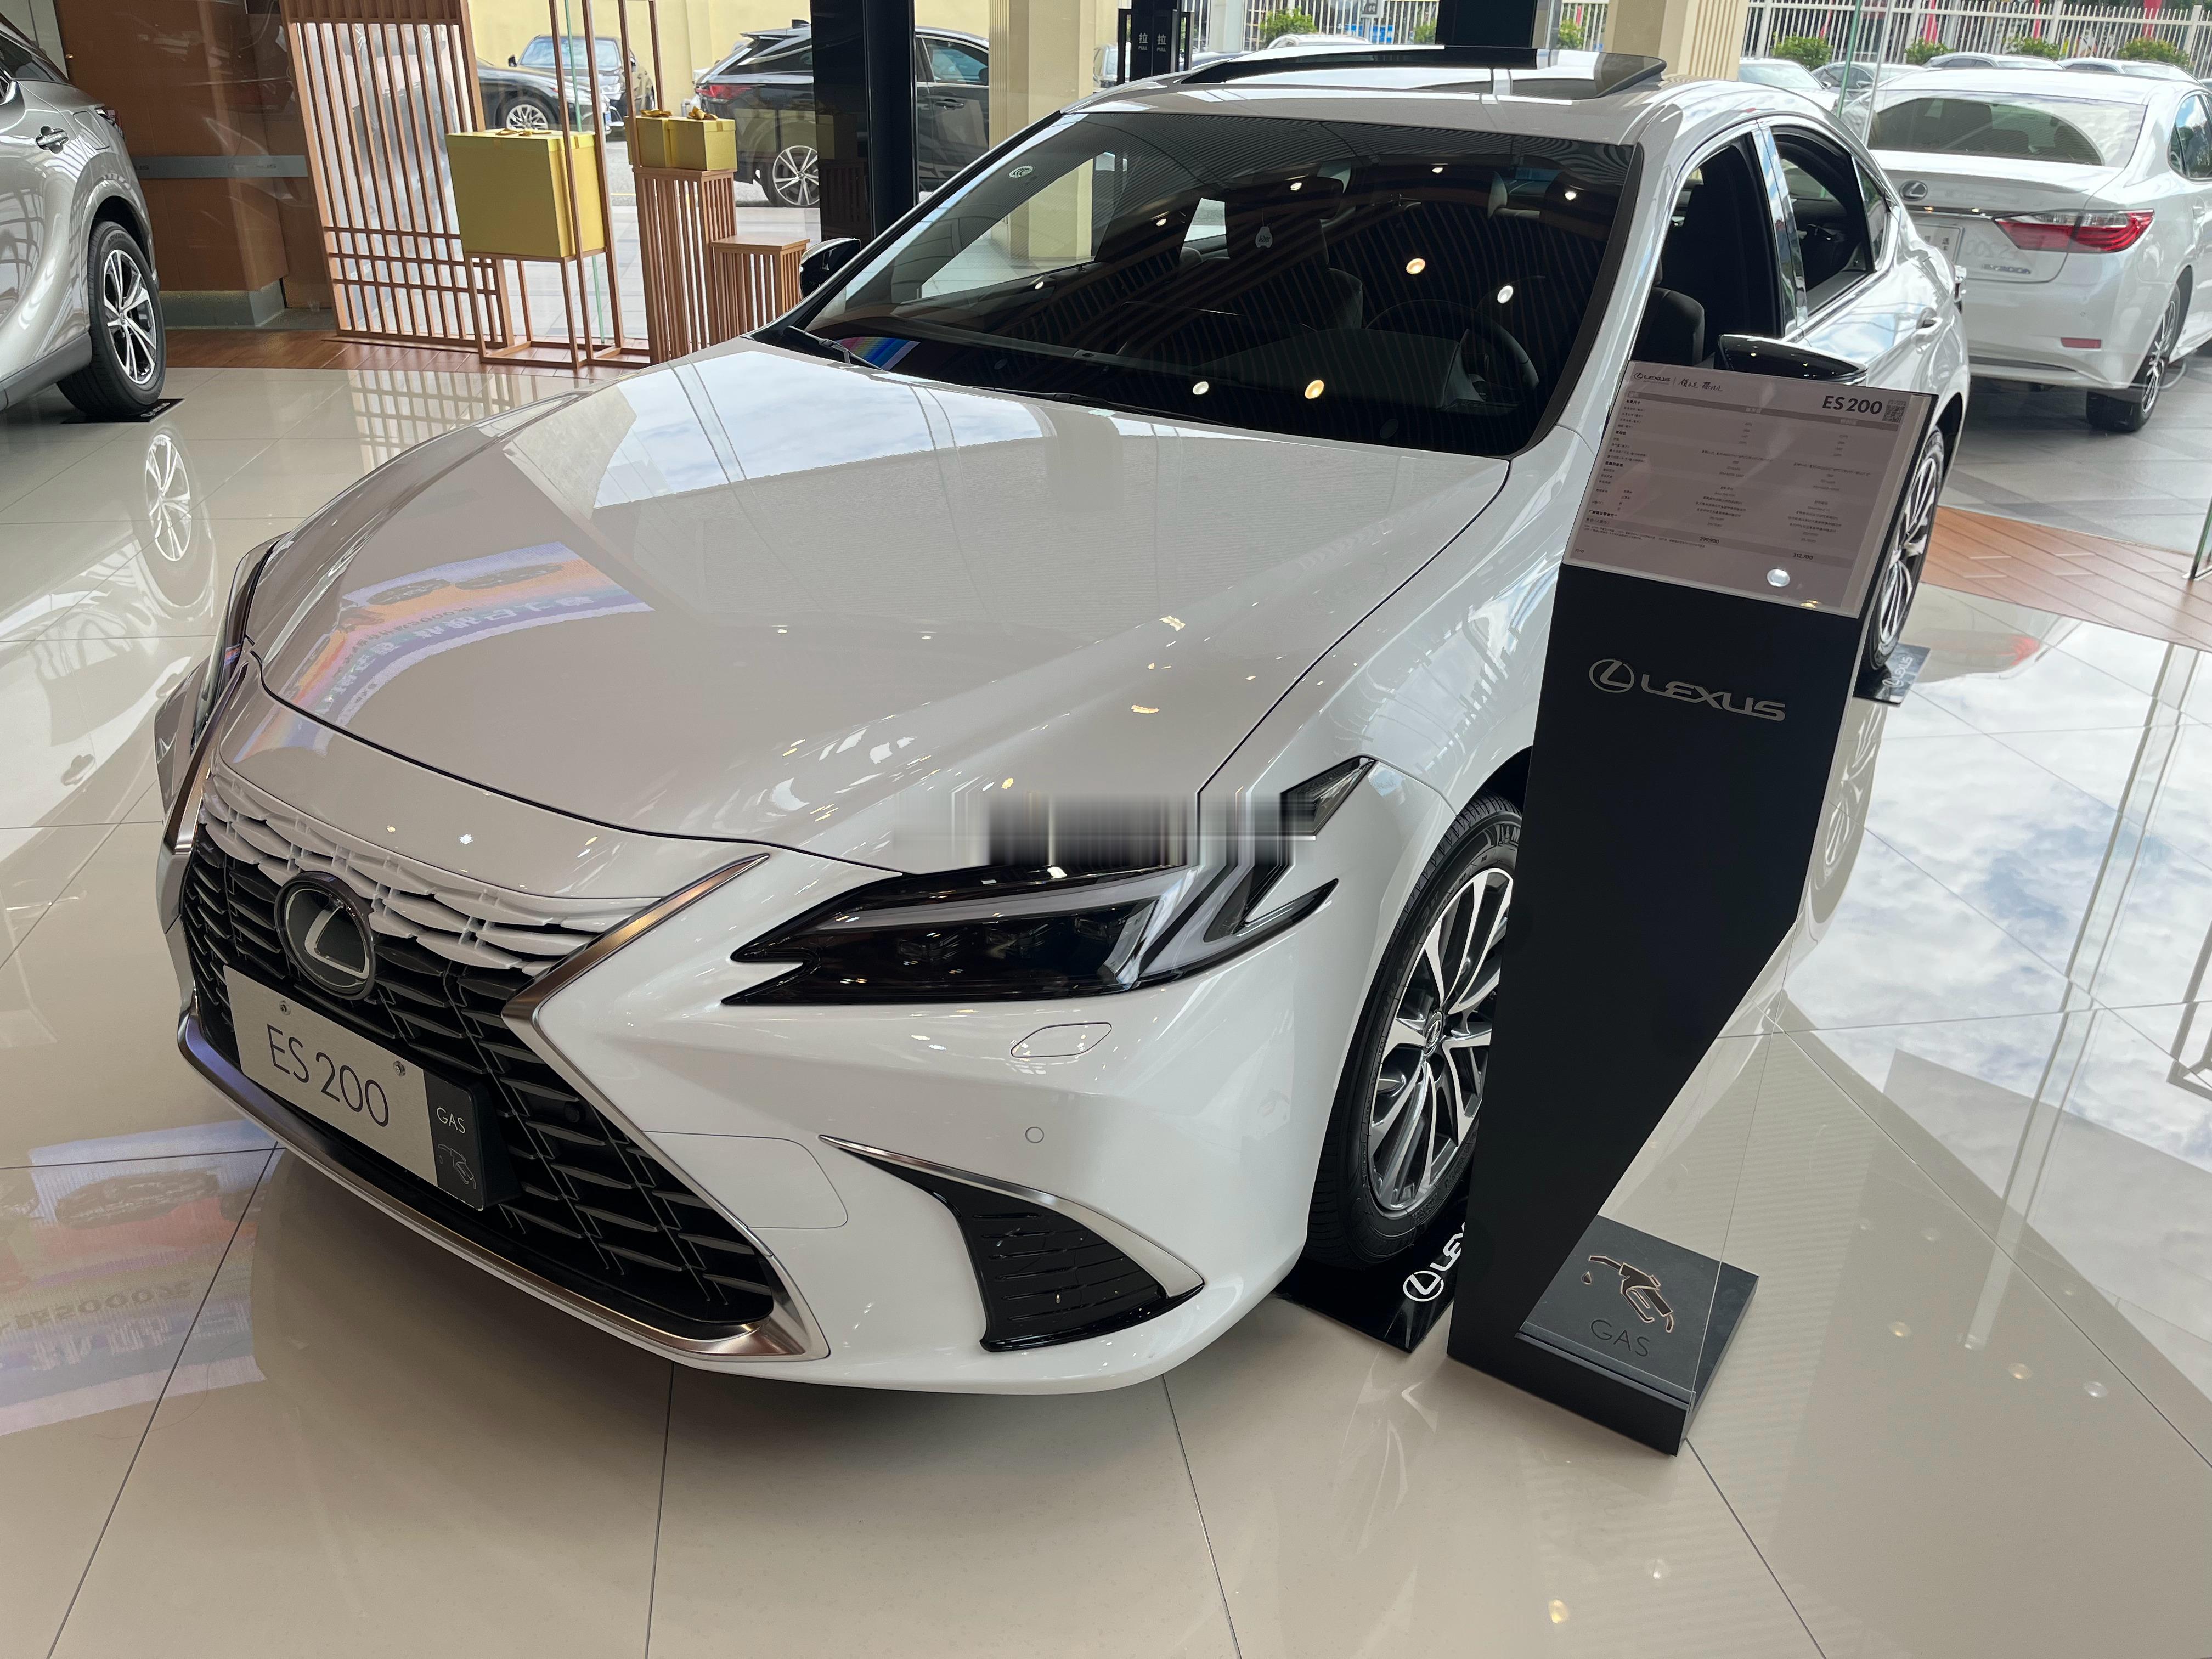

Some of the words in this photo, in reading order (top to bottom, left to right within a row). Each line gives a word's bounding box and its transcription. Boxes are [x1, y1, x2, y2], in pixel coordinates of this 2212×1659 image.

[1139, 32, 1148, 44] 拉
[1158, 34, 1166, 45] 拉
[1822, 395, 1845, 410] ES
[1845, 398, 1882, 415] 200
[1699, 536, 1720, 544] 299,900
[1792, 552, 1813, 560] 312,700
[1641, 674, 1786, 721] LEXUS
[267, 1023, 309, 1084] ES
[315, 1052, 389, 1127] 200
[436, 1107, 466, 1134] GAS
[1590, 1319, 1650, 1357] GAS
